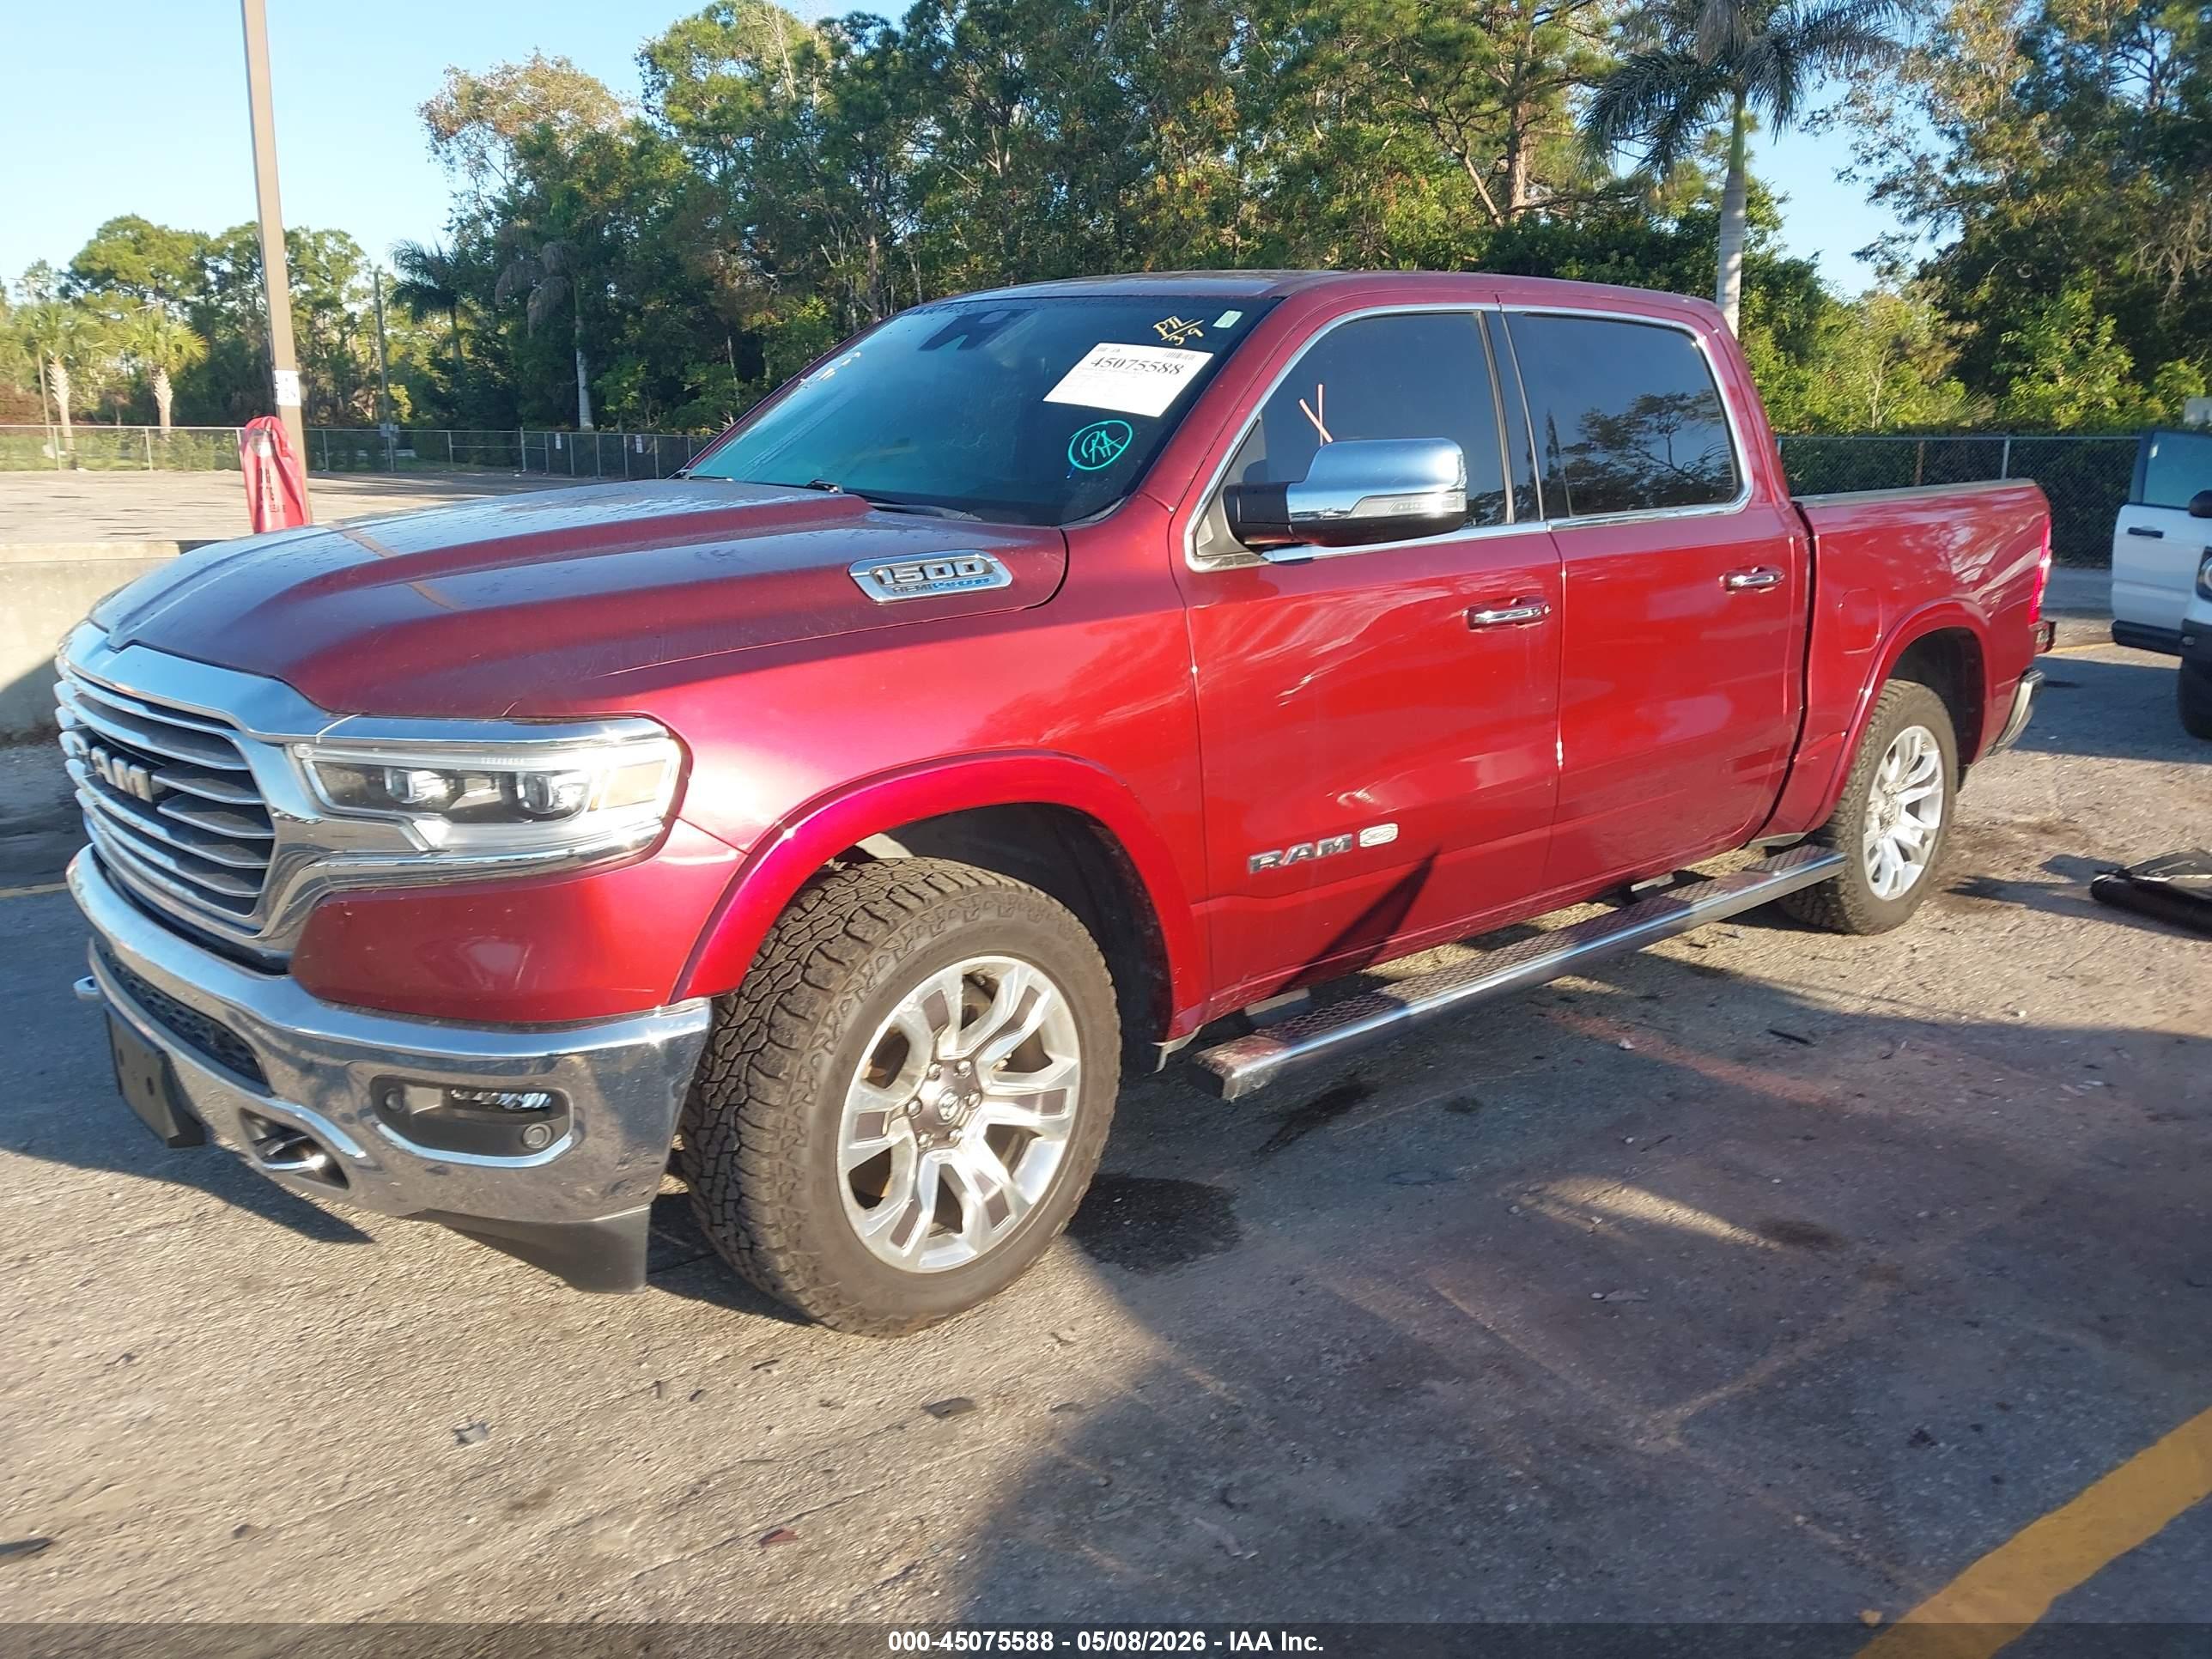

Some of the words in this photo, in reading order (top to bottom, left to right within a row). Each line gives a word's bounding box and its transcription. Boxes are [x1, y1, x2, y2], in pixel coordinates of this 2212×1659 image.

[1091, 356, 1184, 375] 45075588
[874, 560, 985, 586] 1500
[58, 731, 153, 803] RAM
[1249, 833, 1353, 874] RAM
